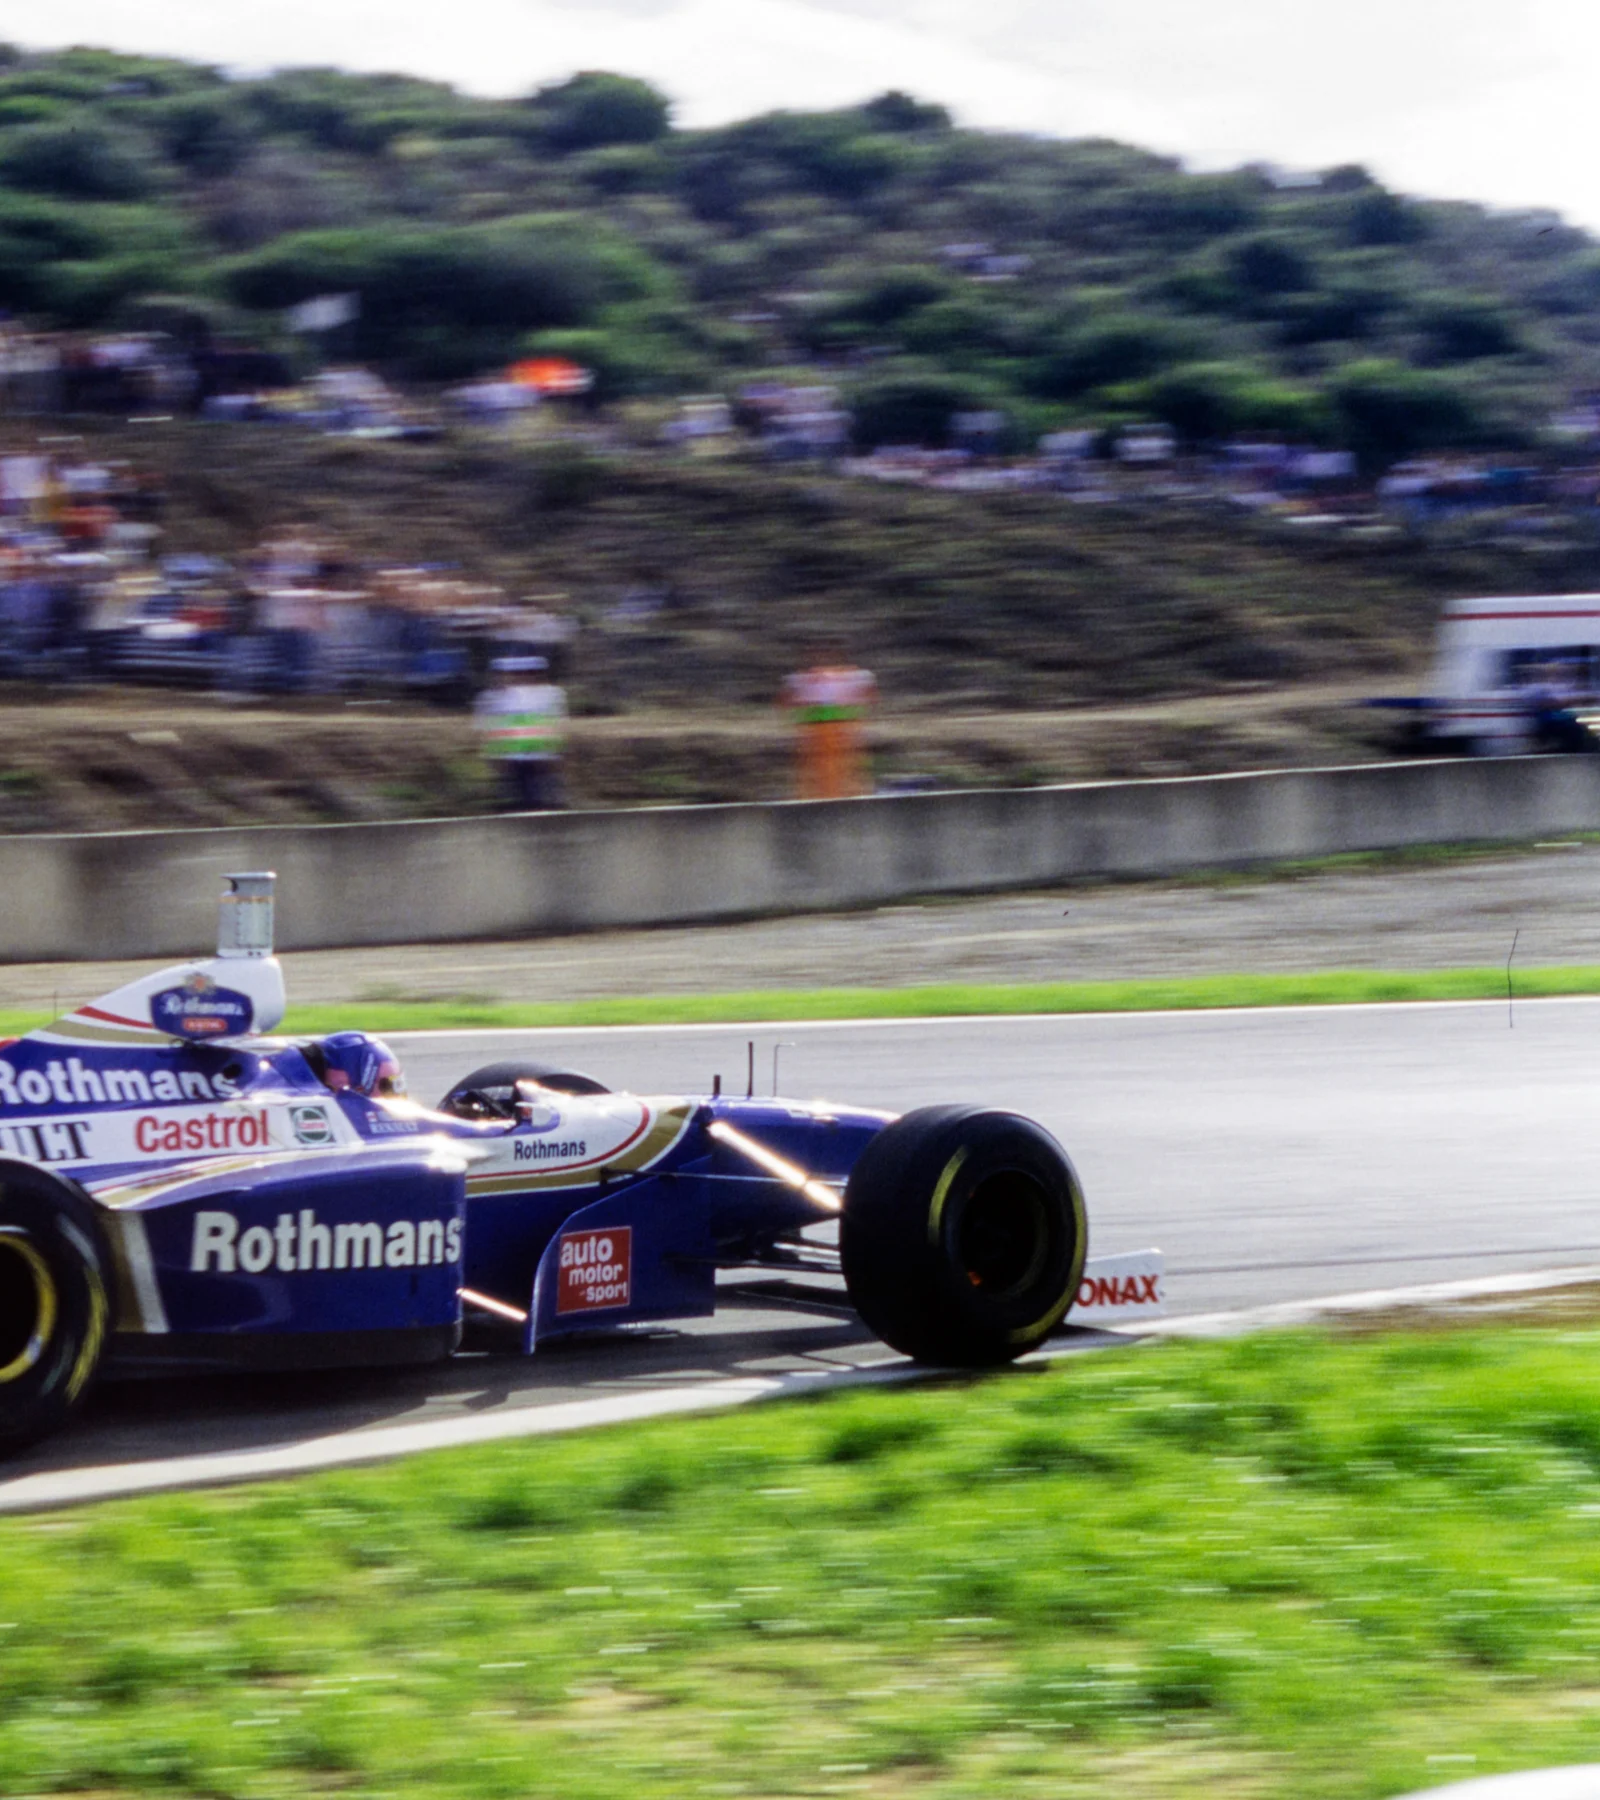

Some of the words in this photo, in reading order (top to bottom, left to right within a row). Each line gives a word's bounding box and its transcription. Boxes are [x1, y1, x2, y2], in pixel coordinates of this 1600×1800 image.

[135, 1109, 269, 1154] Castrol
[513, 1139, 587, 1161] Rothmans
[190, 1208, 463, 1273] Rothmans
[560, 1235, 613, 1268] auto
[567, 1263, 623, 1287] motor
[1076, 1274, 1160, 1308] ONAX
[586, 1281, 627, 1304] sport
